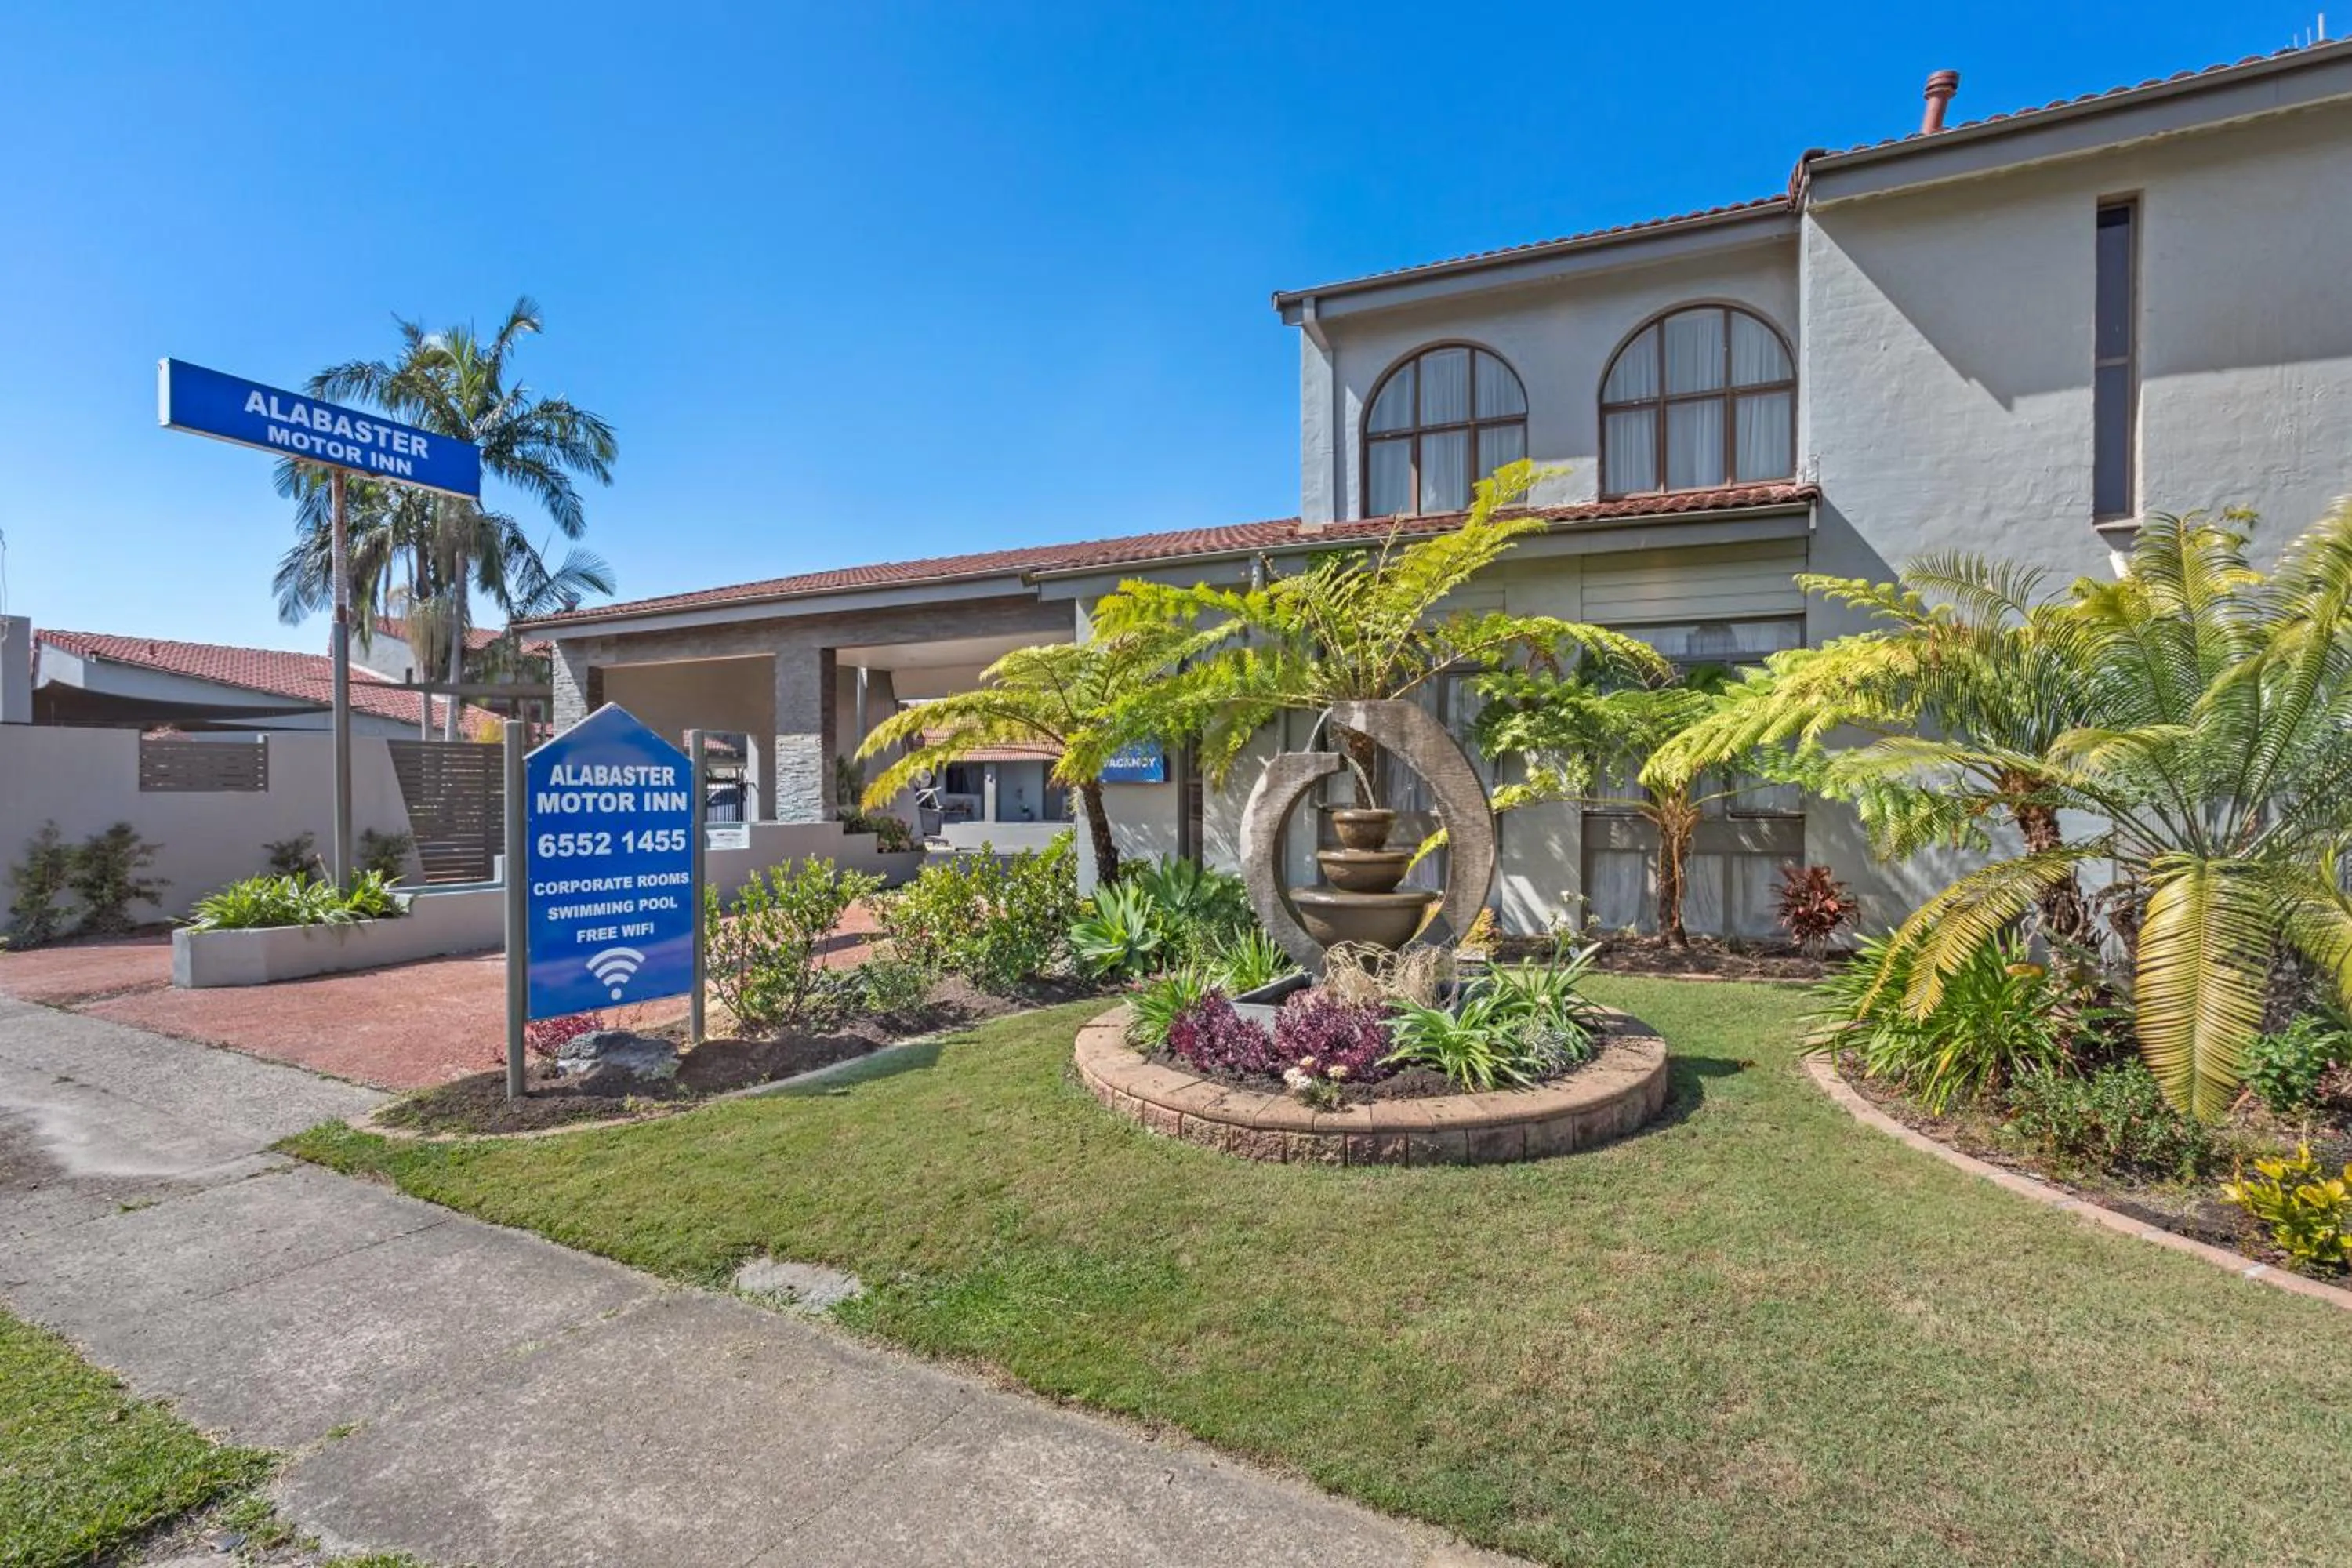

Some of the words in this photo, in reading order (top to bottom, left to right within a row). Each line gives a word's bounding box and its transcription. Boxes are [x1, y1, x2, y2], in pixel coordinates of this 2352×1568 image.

[245, 390, 429, 459] ALABASTER
[267, 425, 361, 463] MOTOR
[370, 452, 412, 476] INN
[550, 765, 675, 786] ALABASTER
[537, 792, 636, 814] MOTOR
[644, 792, 688, 811] INN
[538, 832, 612, 858] 6552
[622, 829, 686, 853] 1455
[534, 877, 633, 895] CORPORATE
[637, 872, 689, 887] ROOMS
[548, 900, 634, 920] SWIMMING
[639, 897, 677, 910] POOL
[576, 926, 617, 943] FREE
[621, 923, 655, 937] WIFI
